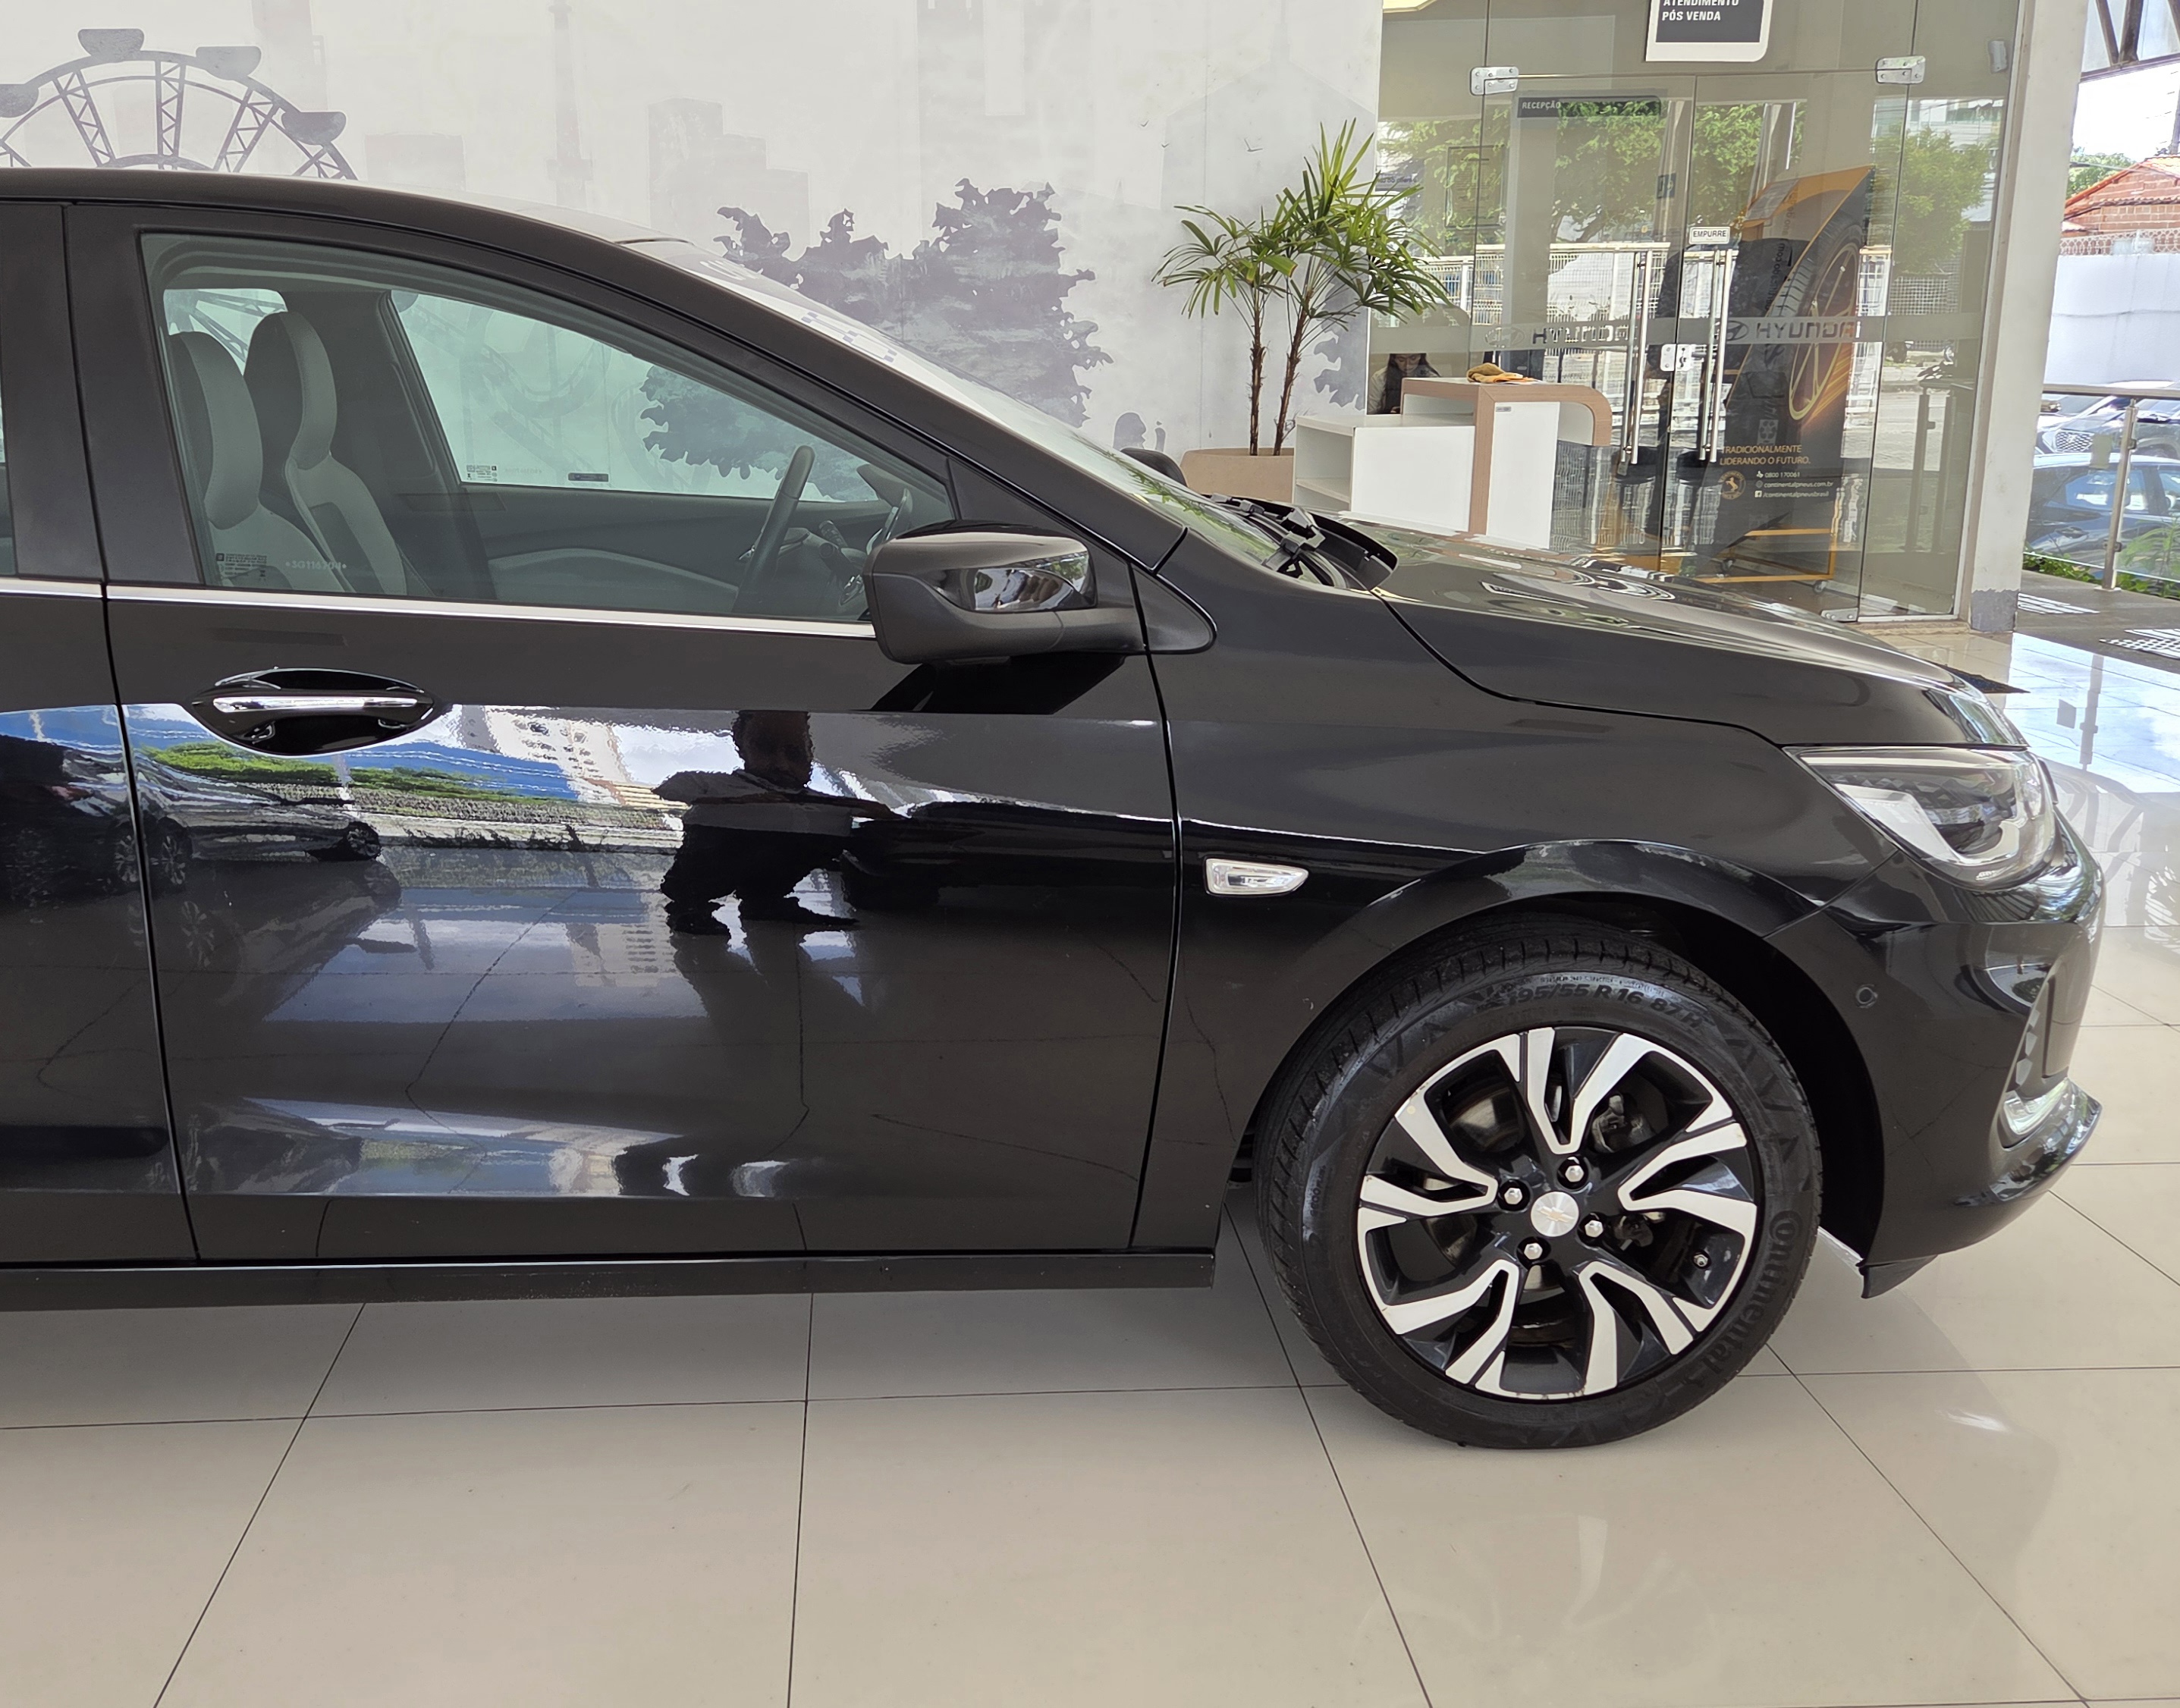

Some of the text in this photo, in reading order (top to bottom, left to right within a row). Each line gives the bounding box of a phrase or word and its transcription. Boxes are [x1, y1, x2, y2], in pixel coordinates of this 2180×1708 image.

[1662, 10, 1721, 21] PÓS VENDA
[1522, 100, 1561, 111] RECEPÇÃO
[1720, 444, 1802, 454] TRADICIONALMENTE
[1720, 456, 1811, 465] LIDERANDO O FUTURO.
[1650, 997, 1683, 1016] 87
